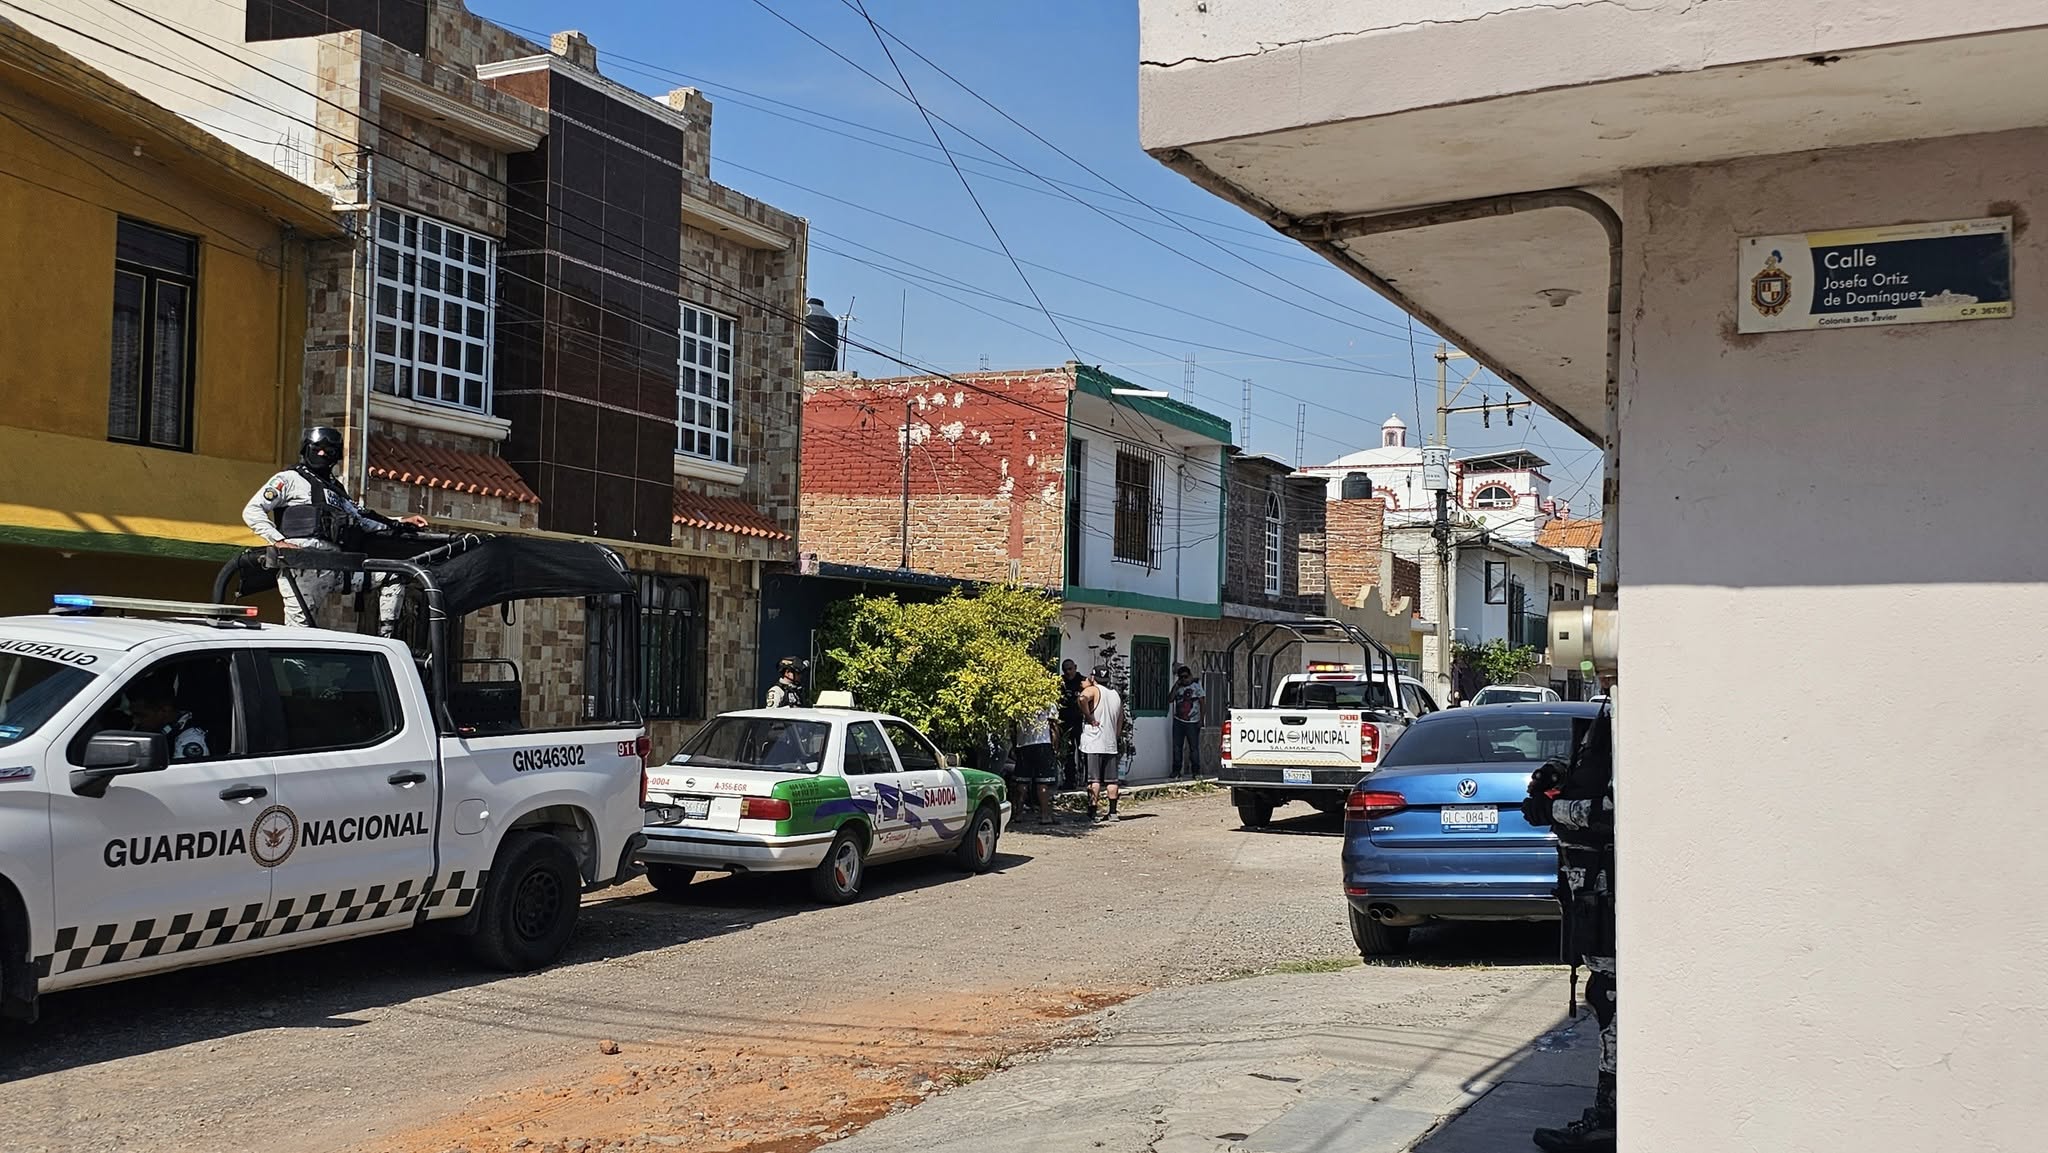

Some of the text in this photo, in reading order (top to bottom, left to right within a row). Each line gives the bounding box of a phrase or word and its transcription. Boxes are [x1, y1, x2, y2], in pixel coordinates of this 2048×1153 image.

[1824, 249, 1877, 269] Calle
[1823, 272, 1909, 289] Josefa Ortiz
[1824, 290, 1926, 306] de Domínguez
[1819, 317, 1851, 325] Colonia
[1871, 314, 1897, 322] Javier
[1961, 308, 1978, 316] C.P.
[1240, 728, 1350, 744] POLICÍA MUNICIPAL
[618, 742, 635, 755] 911
[513, 744, 586, 772] GN346302
[924, 787, 957, 808] SA-0004
[1443, 811, 1496, 824] GLC-084-G
[104, 828, 247, 869] GUARDIA
[301, 811, 429, 848] NACIONAL
